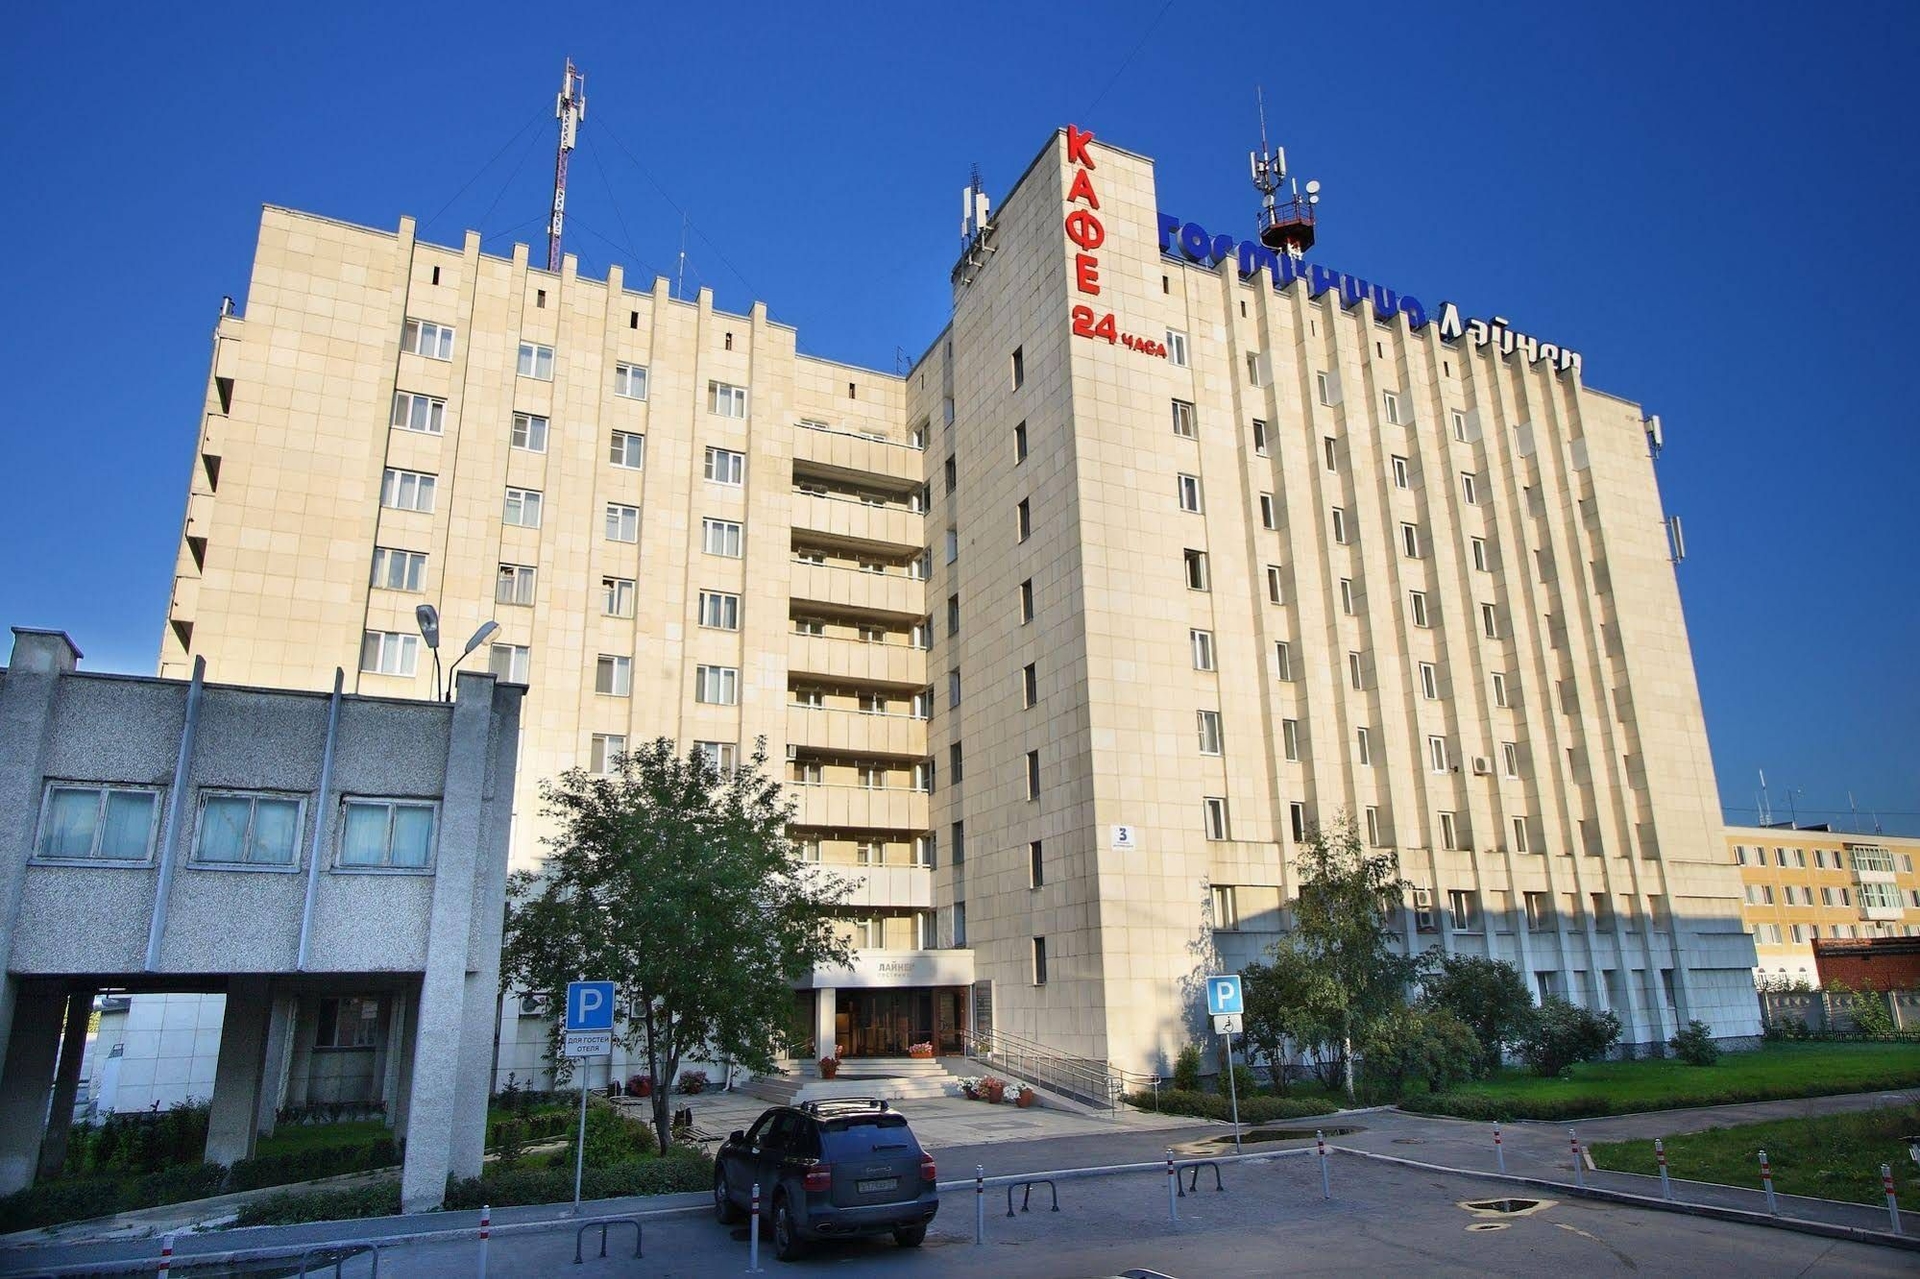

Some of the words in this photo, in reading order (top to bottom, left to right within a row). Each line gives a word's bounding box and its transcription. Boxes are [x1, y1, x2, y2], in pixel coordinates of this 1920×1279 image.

[1065, 123, 1106, 296] КАФЕ
[1072, 304, 1118, 345] 24
[1121, 332, 1168, 360] ЧАСА
[1119, 827, 1127, 841] 3
